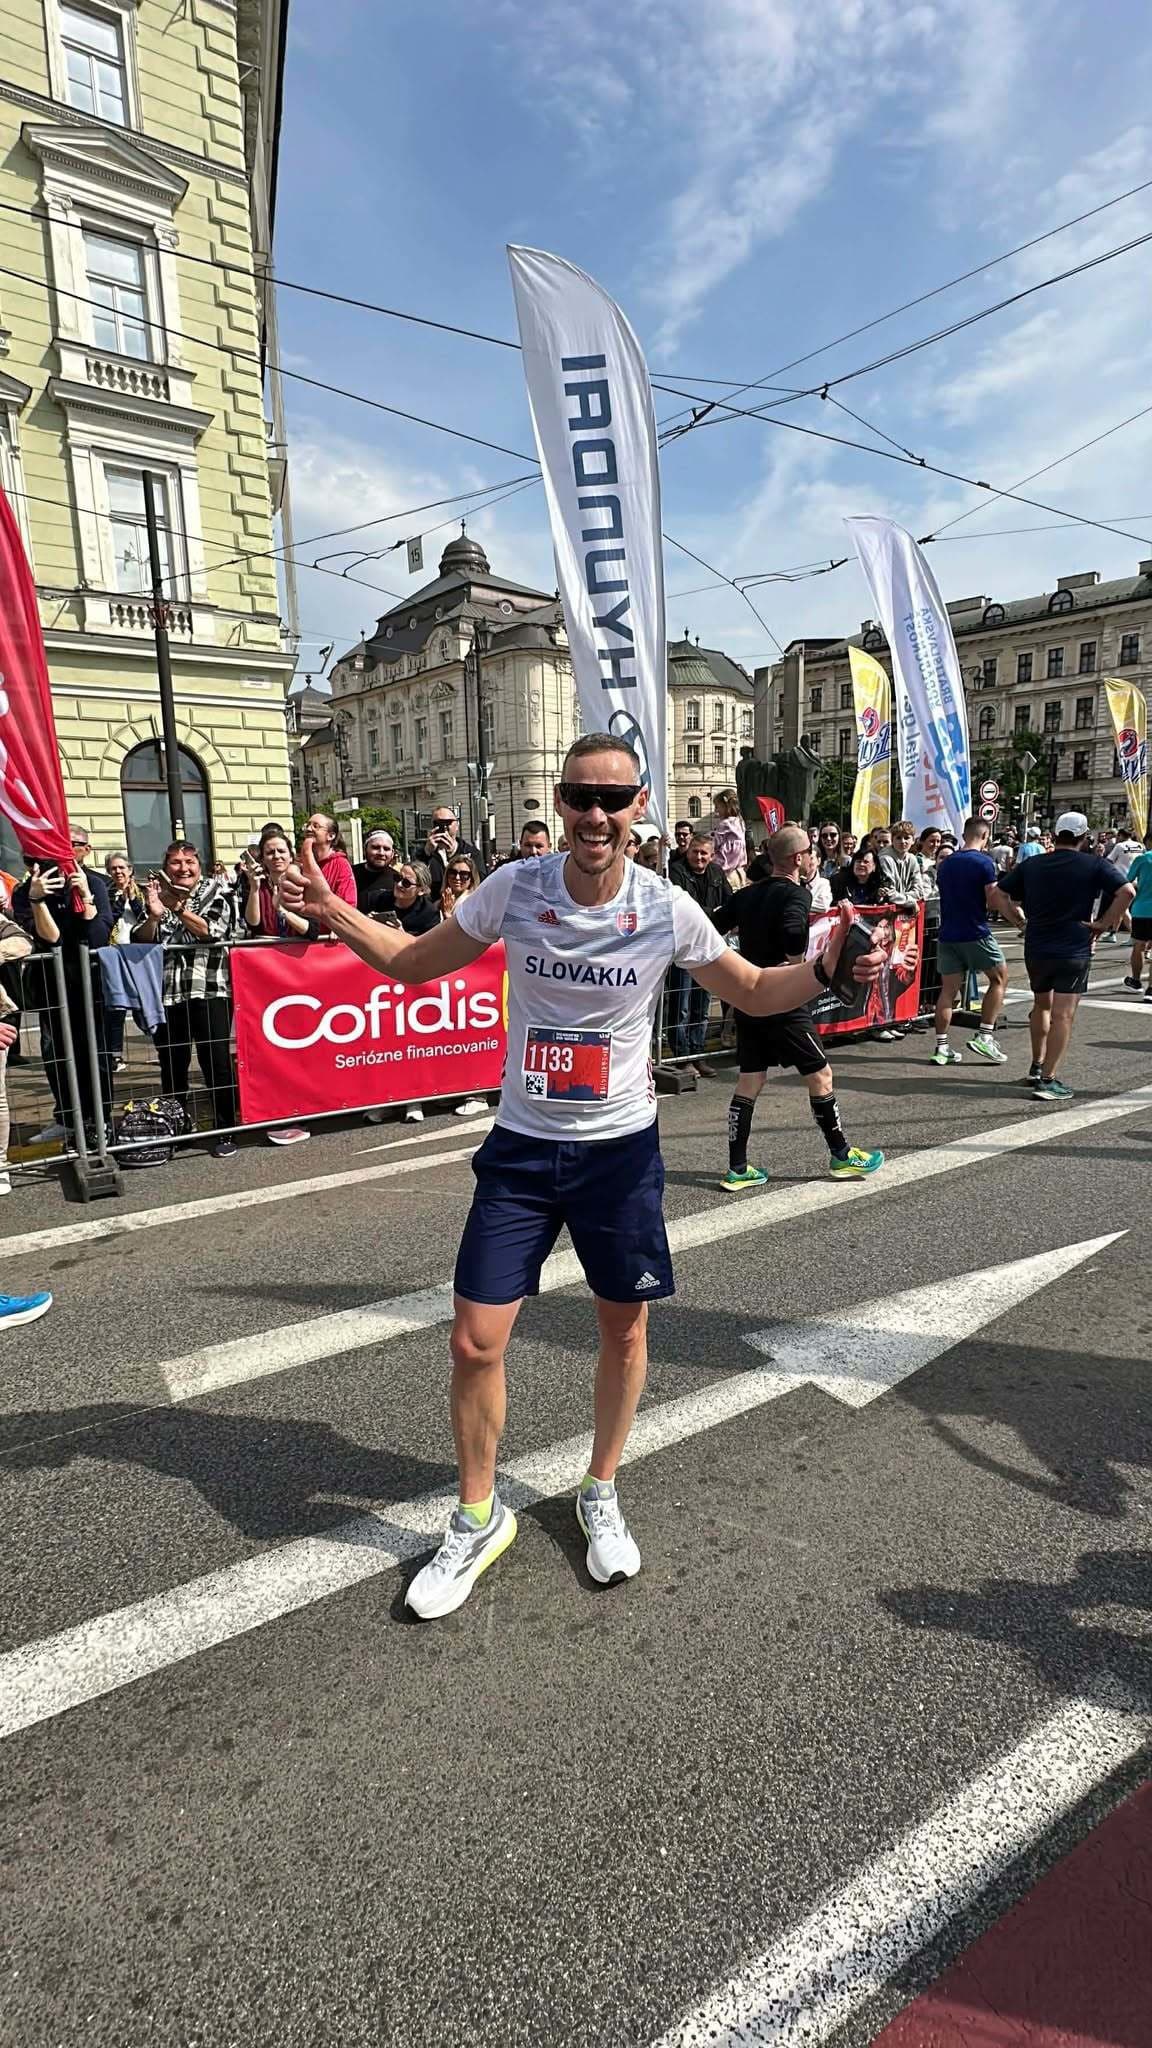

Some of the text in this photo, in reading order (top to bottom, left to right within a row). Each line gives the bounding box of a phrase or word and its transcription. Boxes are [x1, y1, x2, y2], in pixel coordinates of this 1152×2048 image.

[410, 547, 420, 563] 15
[525, 955, 638, 987] SLOVAKIA
[262, 979, 500, 1049] Cofidis
[335, 1037, 499, 1069] Seriózne financovanie
[529, 1044, 574, 1073] 1133
